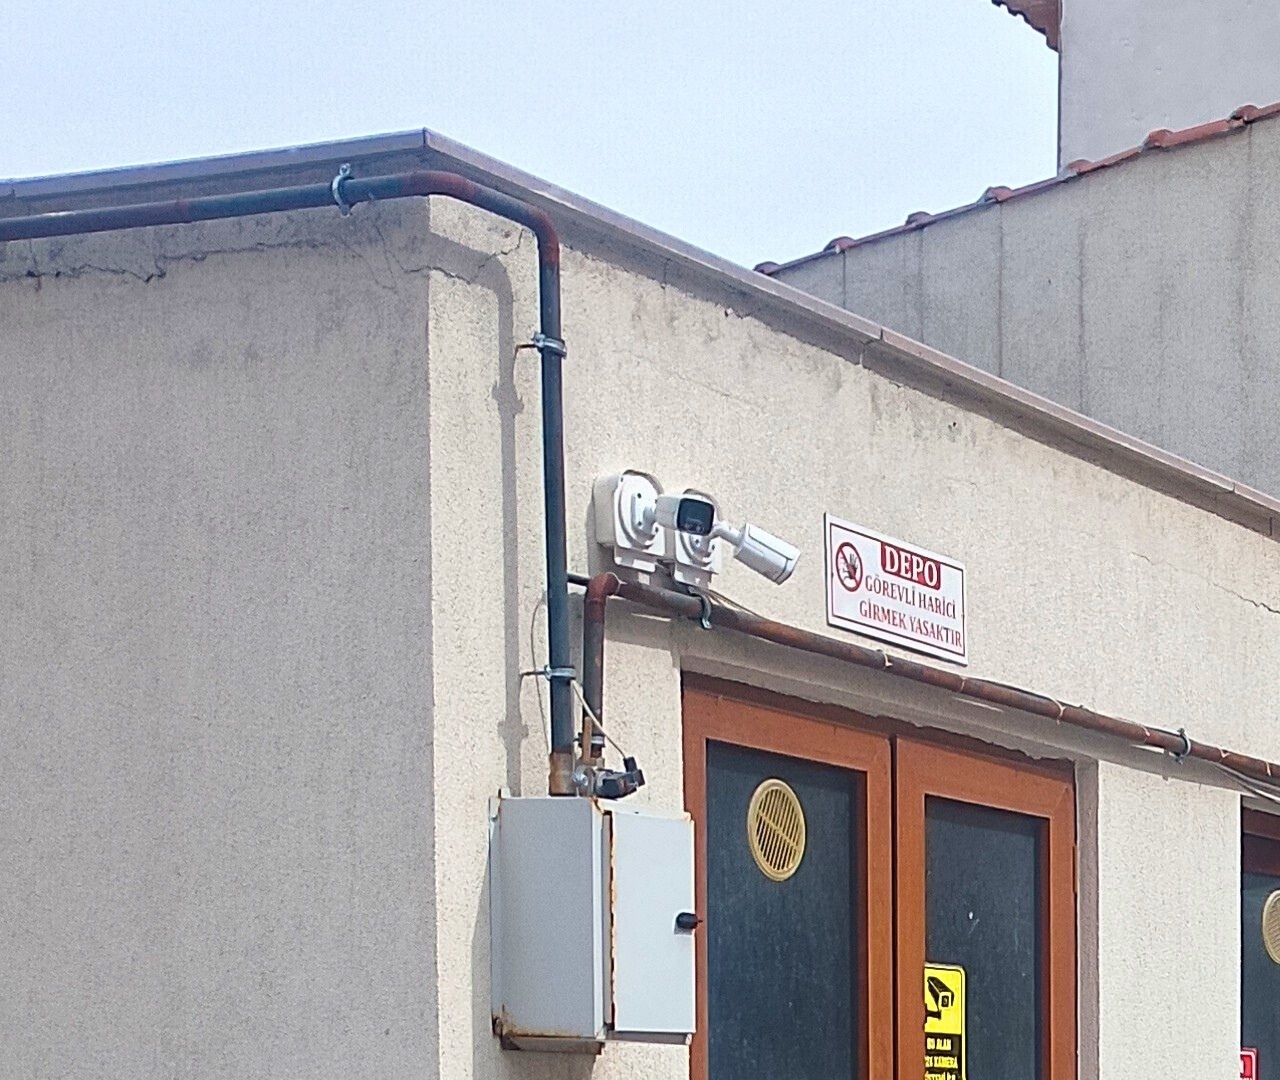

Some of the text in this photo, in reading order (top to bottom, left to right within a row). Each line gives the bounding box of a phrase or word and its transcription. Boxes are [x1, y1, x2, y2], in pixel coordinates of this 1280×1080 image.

[885, 545, 938, 587] DEPO
[865, 574, 956, 619] GÖREVLİ HARİCİ
[860, 598, 962, 647] GİRMEK YASAKTIR
